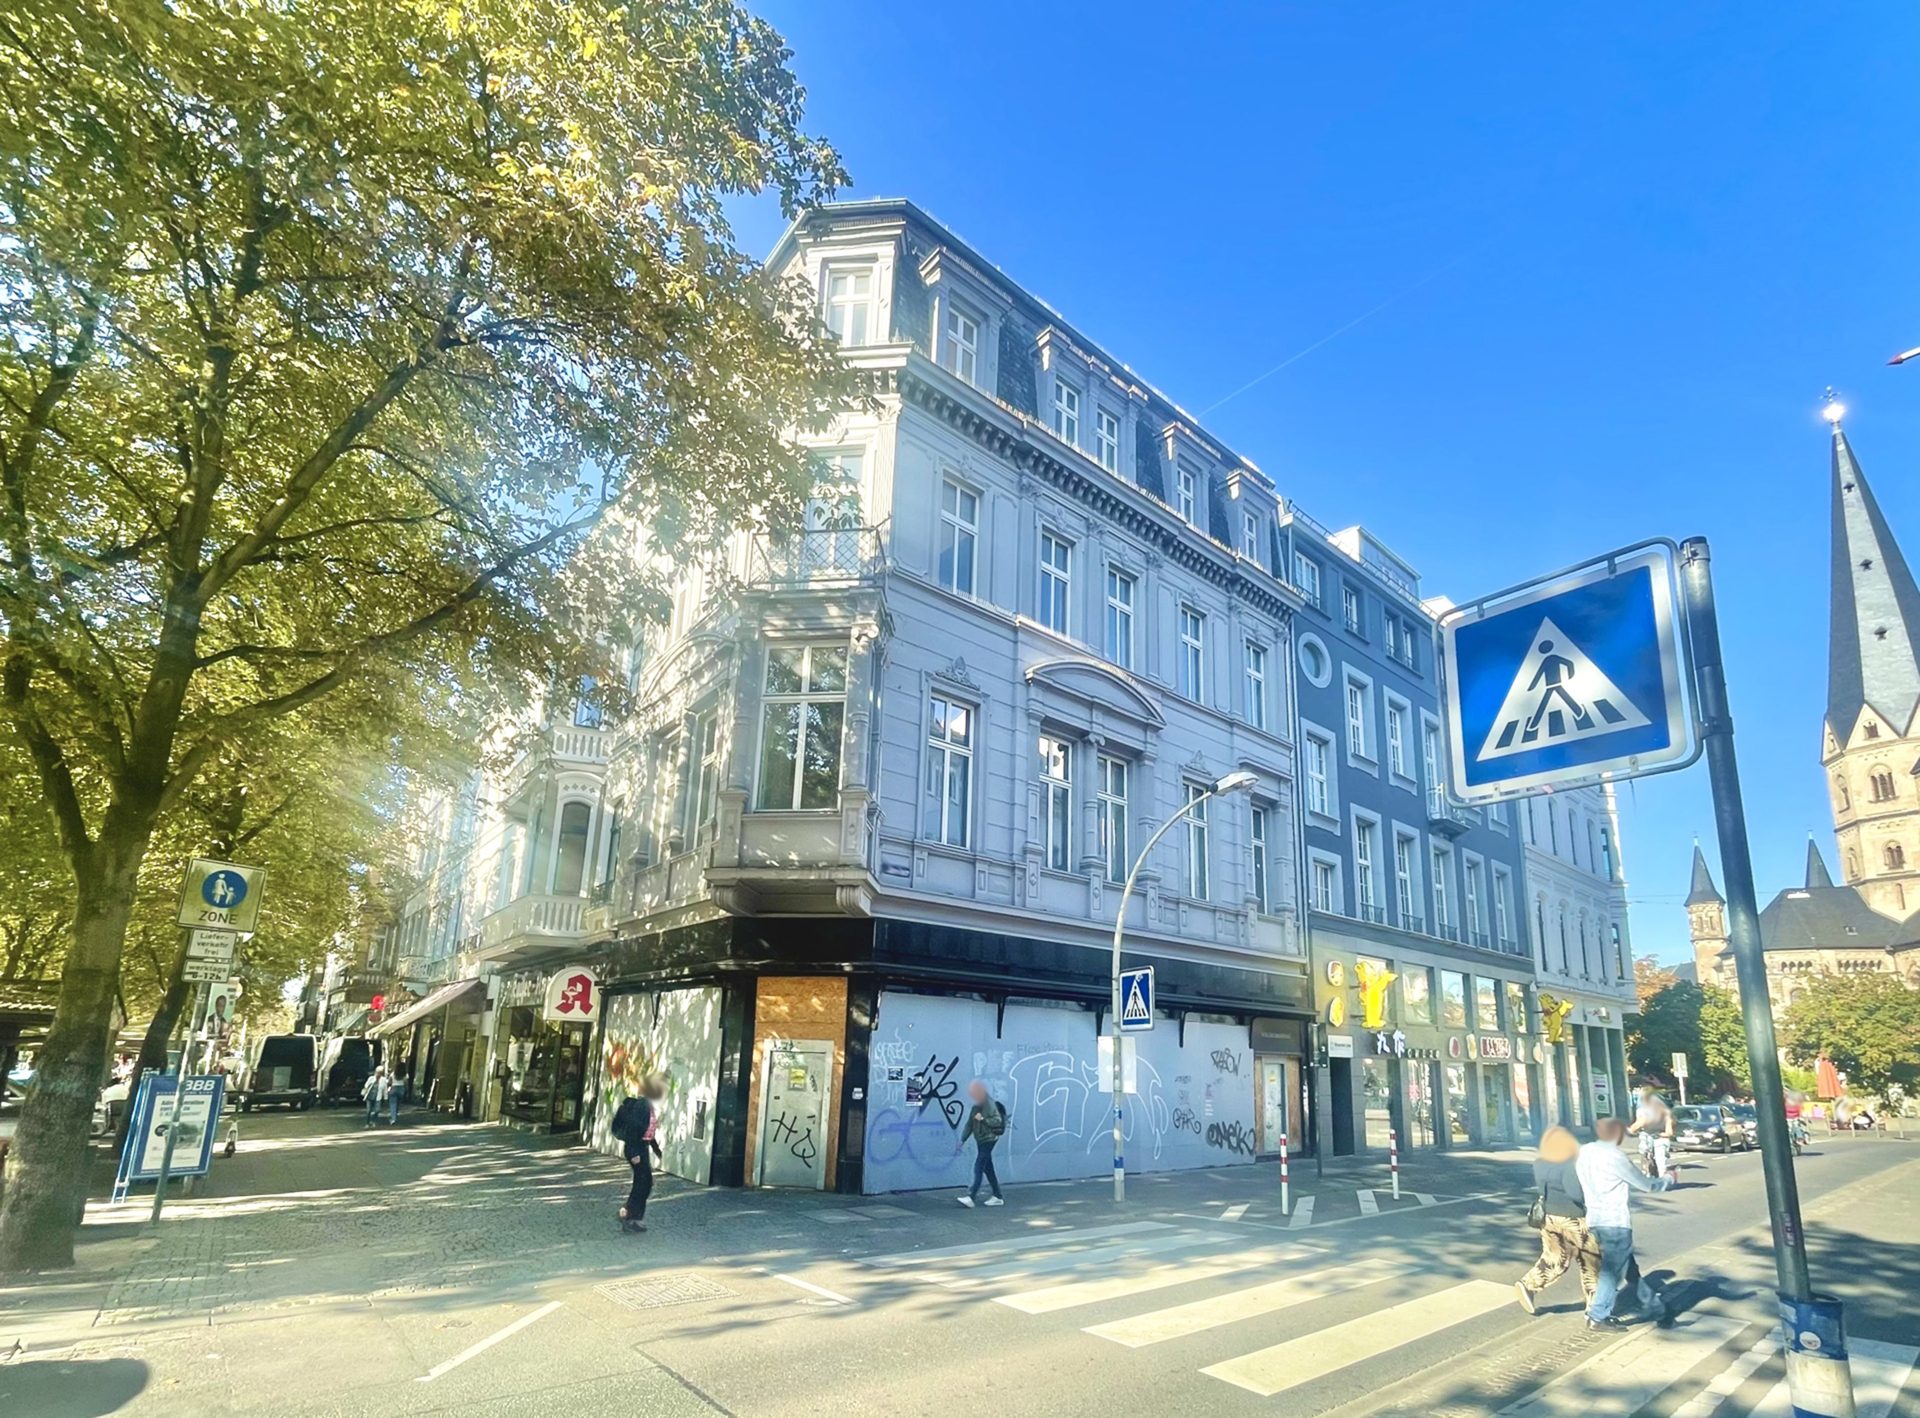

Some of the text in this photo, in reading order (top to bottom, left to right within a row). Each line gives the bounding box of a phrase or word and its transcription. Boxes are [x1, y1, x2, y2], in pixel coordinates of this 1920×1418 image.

[198, 911, 238, 925] ZONE
[200, 932, 230, 940] Liefer-
[196, 941, 229, 949] verkehr
[204, 949, 219, 957] frei
[188, 964, 227, 974] werktags
